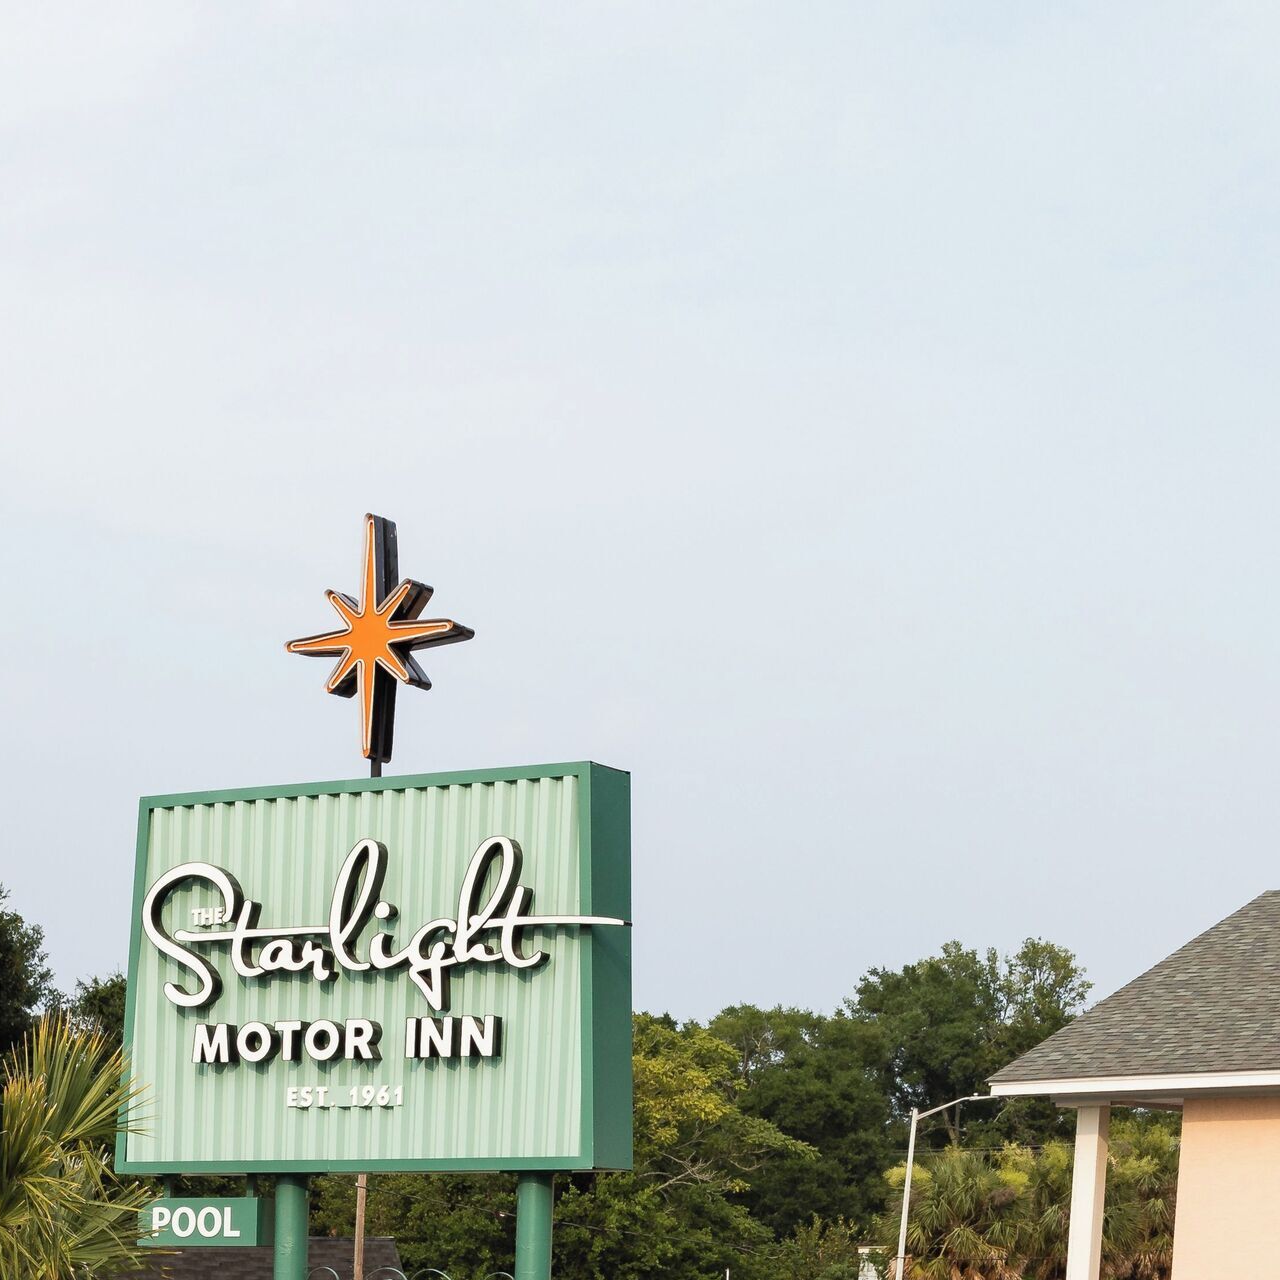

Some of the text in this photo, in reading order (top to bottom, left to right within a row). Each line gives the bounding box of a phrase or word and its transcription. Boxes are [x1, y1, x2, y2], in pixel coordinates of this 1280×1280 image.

[141, 835, 632, 1011] Starlight
[191, 908, 225, 927] THE
[192, 1014, 502, 1065] MOTOR INN
[286, 1085, 404, 1109] EST. 1961
[151, 1205, 241, 1239] POOL
